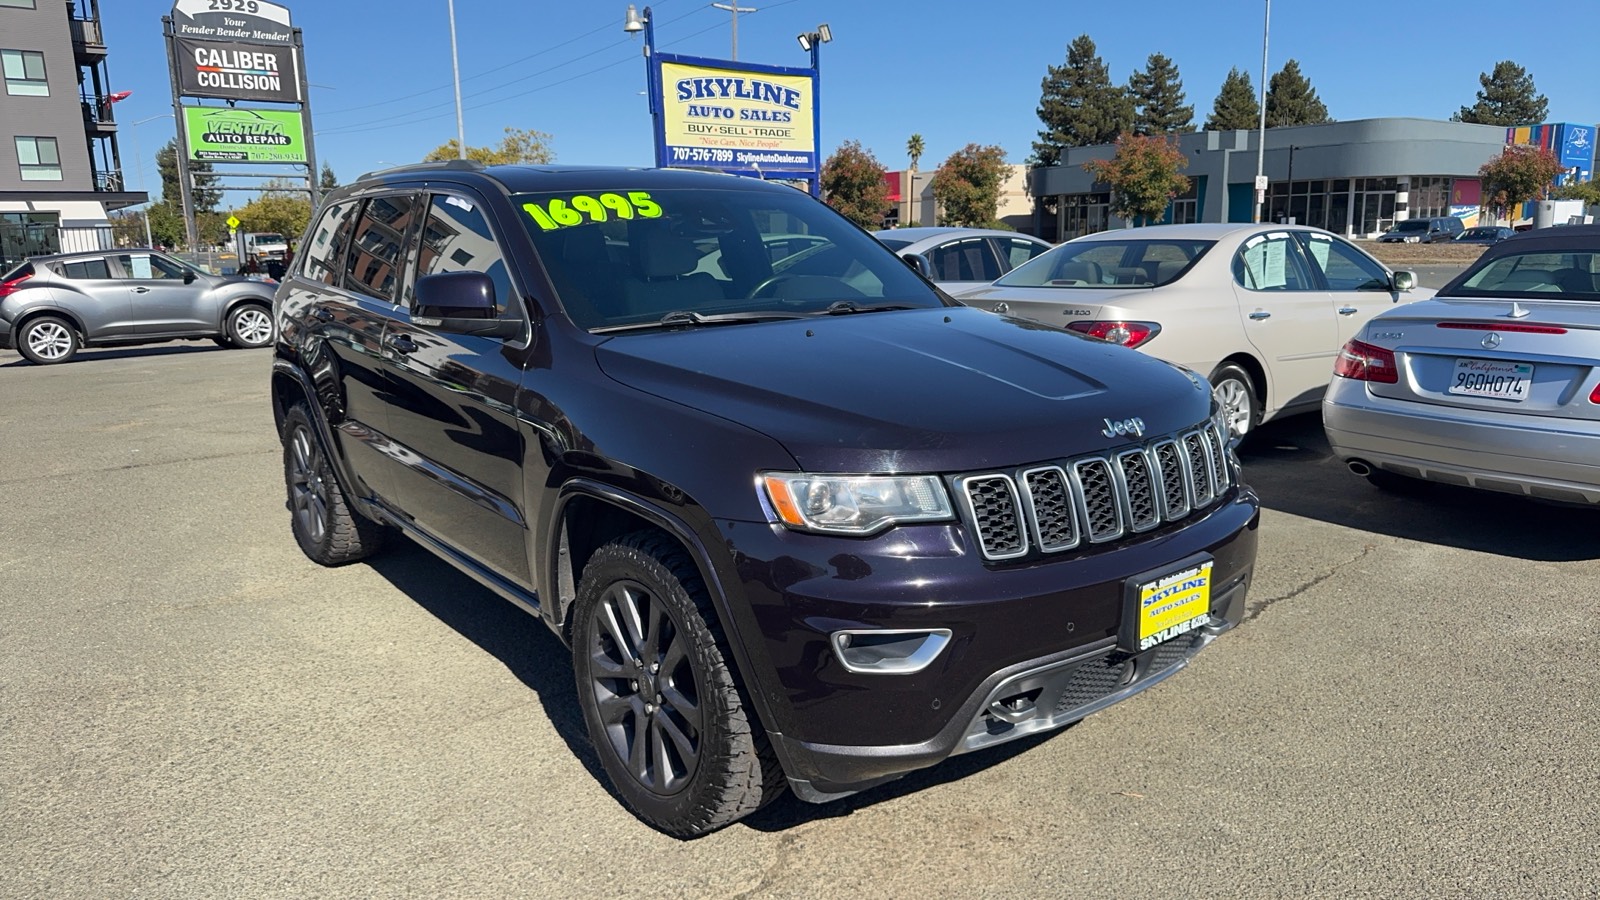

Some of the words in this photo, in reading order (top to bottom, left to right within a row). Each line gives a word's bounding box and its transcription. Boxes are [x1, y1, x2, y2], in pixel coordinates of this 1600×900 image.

[208, 0, 259, 14] 2929
[224, 17, 246, 27] Your
[181, 25, 215, 35] Fender
[216, 28, 250, 38] Bender
[252, 31, 290, 41] Mender!
[195, 48, 278, 71] CALIBER
[197, 72, 281, 91] COLLISION
[677, 77, 801, 111] SKYLINE
[688, 104, 734, 119] AUTO
[740, 109, 791, 122] SALES
[208, 120, 284, 135] VENTURA
[688, 124, 713, 133] BUY
[720, 127, 748, 135] SELL
[753, 128, 791, 137] TRADE
[208, 135, 242, 143] AUTO
[246, 136, 287, 144] REPAIR
[673, 147, 733, 162] 707-576-7899
[737, 152, 808, 164] SkylineAutoDealer.com
[522, 192, 662, 230] 16995
[1470, 361, 1517, 374] California
[1102, 417, 1146, 438] Jeep
[1143, 577, 1206, 608] SKYLINE
[1149, 604, 1173, 618] AUTO
[1173, 593, 1201, 607] SALES
[1140, 621, 1190, 650] SKYLINE
